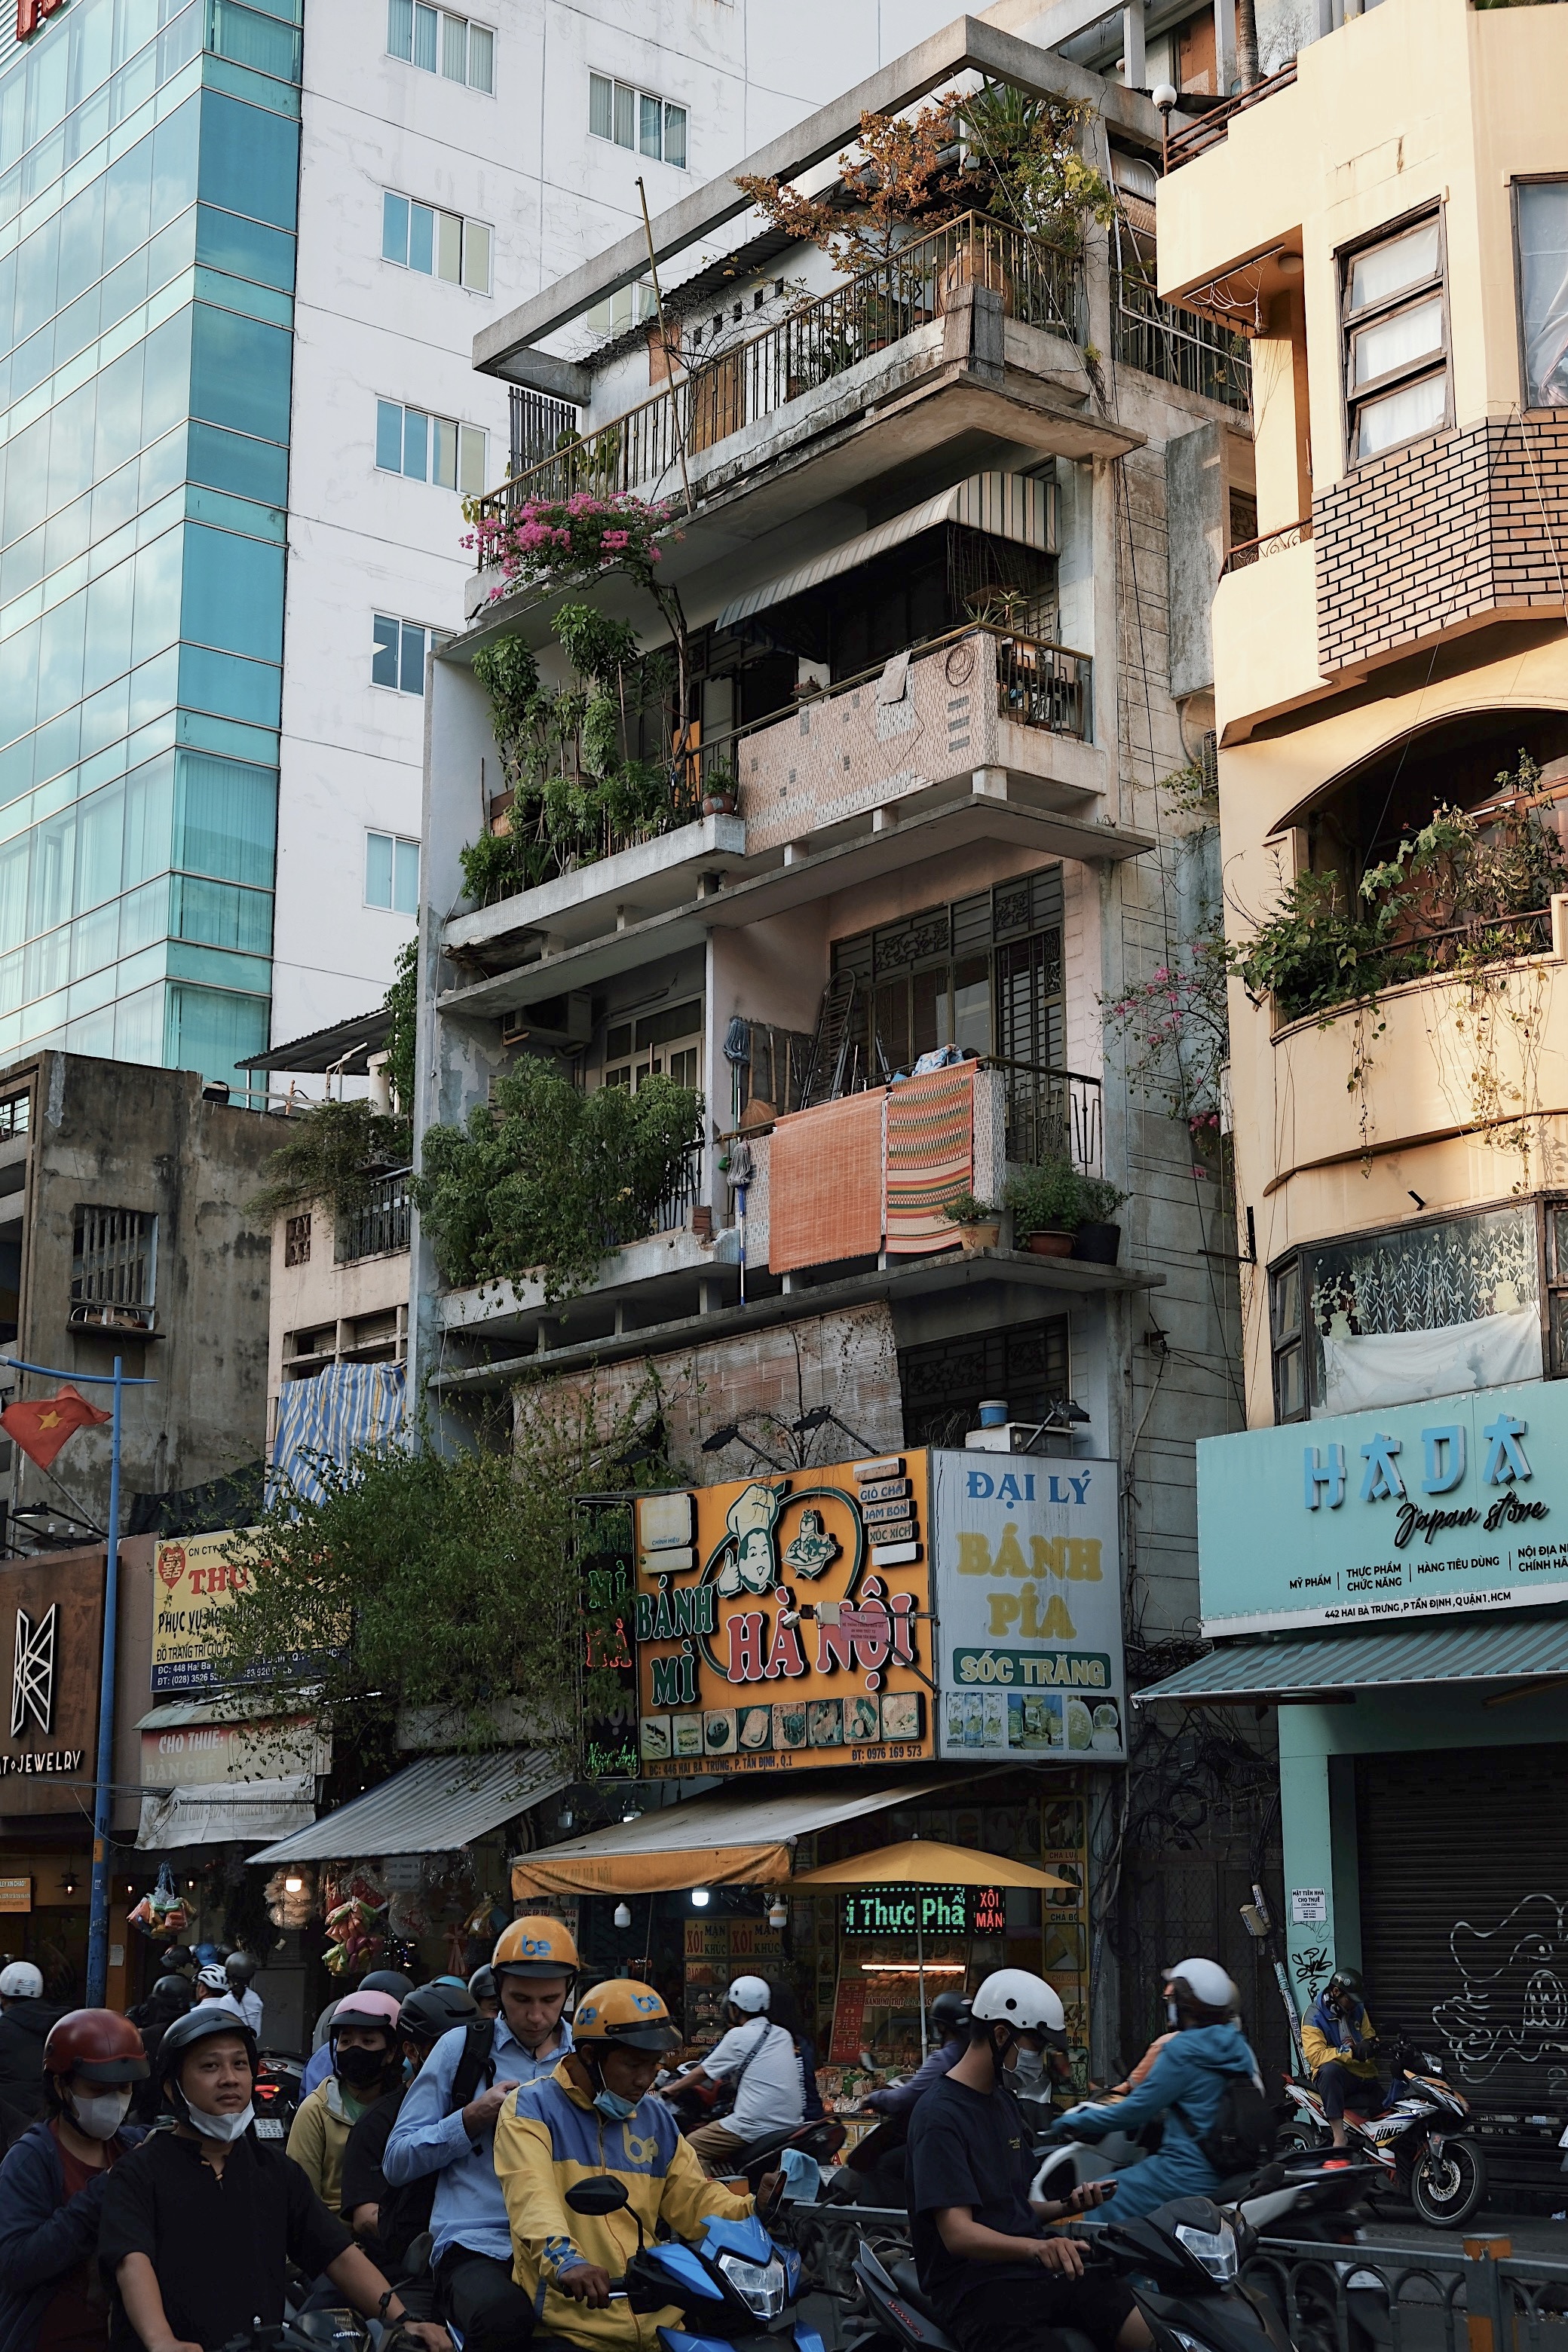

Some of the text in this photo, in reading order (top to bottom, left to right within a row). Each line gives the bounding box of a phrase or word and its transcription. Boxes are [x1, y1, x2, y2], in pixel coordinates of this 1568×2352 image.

[1304, 1413, 1532, 1511] HADA
[860, 1486, 878, 1500] GIÒ
[966, 1469, 1092, 1509] ĐẠI LÝ
[865, 1508, 884, 1521] JAM
[1394, 1490, 1550, 1549] Japan store
[870, 1525, 911, 1542] XÚC XÍCH
[188, 1547, 200, 1557] CN
[956, 1522, 1103, 1582] BÁNH
[1517, 1545, 1536, 1559] NỘI
[1539, 1545, 1557, 1557] ĐỊA
[1346, 1560, 1401, 1579] THỰC PHẨM
[1417, 1554, 1499, 1573] HÀNG TIÊU DÙNG
[1518, 1558, 1551, 1572] CHÍNH
[1290, 1573, 1331, 1589] MỸ PHẨM
[1347, 1576, 1402, 1591] CHỨC NĂNG
[635, 1574, 713, 1641] BÁNH
[986, 1582, 1077, 1640] PÍA
[1325, 1609, 1340, 1619] 442
[1341, 1608, 1355, 1617] HAI
[1358, 1605, 1369, 1615] BÀ
[158, 1610, 185, 1640] PHỤC
[726, 1575, 914, 1691] HÀ NỘI
[158, 1665, 171, 1675] ĐC:
[173, 1664, 185, 1673] 448
[650, 1639, 697, 1707] MÌ
[960, 1649, 1106, 1687] SÓC TRĂNG
[157, 1677, 170, 1686] ĐT:
[172, 1675, 189, 1686] (028)
[191, 1673, 208, 1683] 3526
[158, 1734, 184, 1754] CHO
[188, 1727, 224, 1752] THUÊ:
[17, 1750, 81, 1774] JEWELRY
[852, 1745, 922, 1761] ĐT: 0976 169 573
[145, 1759, 180, 1782] BÀN
[663, 1764, 677, 1775] 446
[678, 1762, 691, 1774] HAI
[694, 1760, 703, 1773] BÀ
[734, 1759, 741, 1770] P.
[743, 1755, 756, 1769] TÂN
[780, 1754, 793, 1766] Q.1
[980, 1888, 999, 1908] XÔI
[860, 1897, 915, 1933] Thực
[975, 1909, 1003, 1933] MẶN
[1050, 1910, 1066, 1922] CHẢ
[522, 1934, 551, 1957] be
[687, 1923, 703, 1953] XÔI
[732, 1923, 752, 1954] XÔI
[705, 1940, 779, 1955] KHÚC KHÚC
[630, 1993, 661, 2013] be
[864, 1995, 881, 2007] BÁNH
[890, 1997, 905, 2009] THỊT
